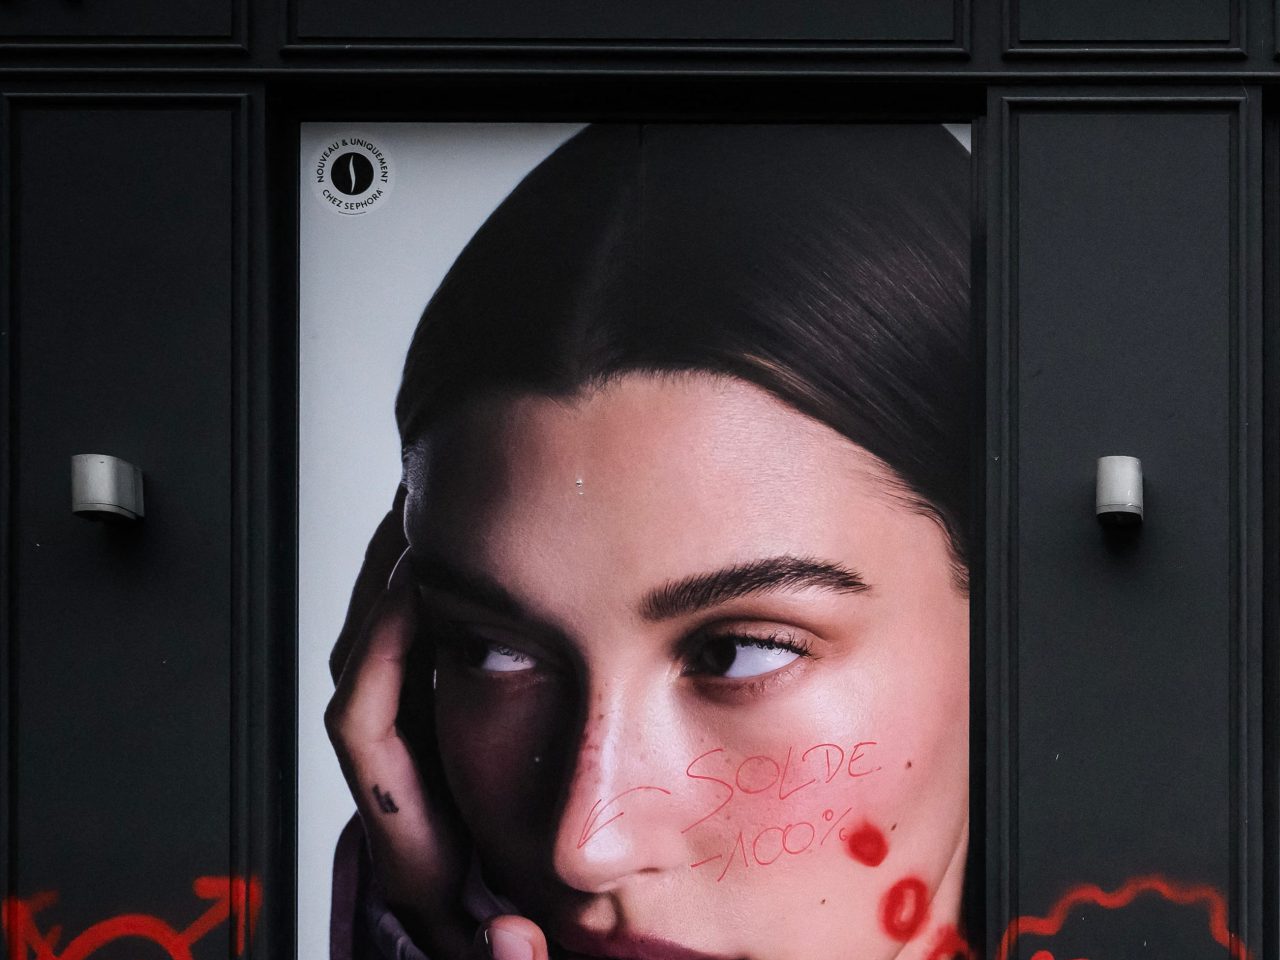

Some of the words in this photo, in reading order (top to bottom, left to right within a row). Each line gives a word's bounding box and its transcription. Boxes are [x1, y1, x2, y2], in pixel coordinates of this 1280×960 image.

[316, 142, 340, 183] NOUVEAU
[341, 139, 348, 147] &
[350, 138, 388, 183] UNIQUEMENT
[322, 189, 343, 208] CHEZ
[344, 188, 384, 210] SEPHORA
[681, 742, 882, 834] SOLDE
